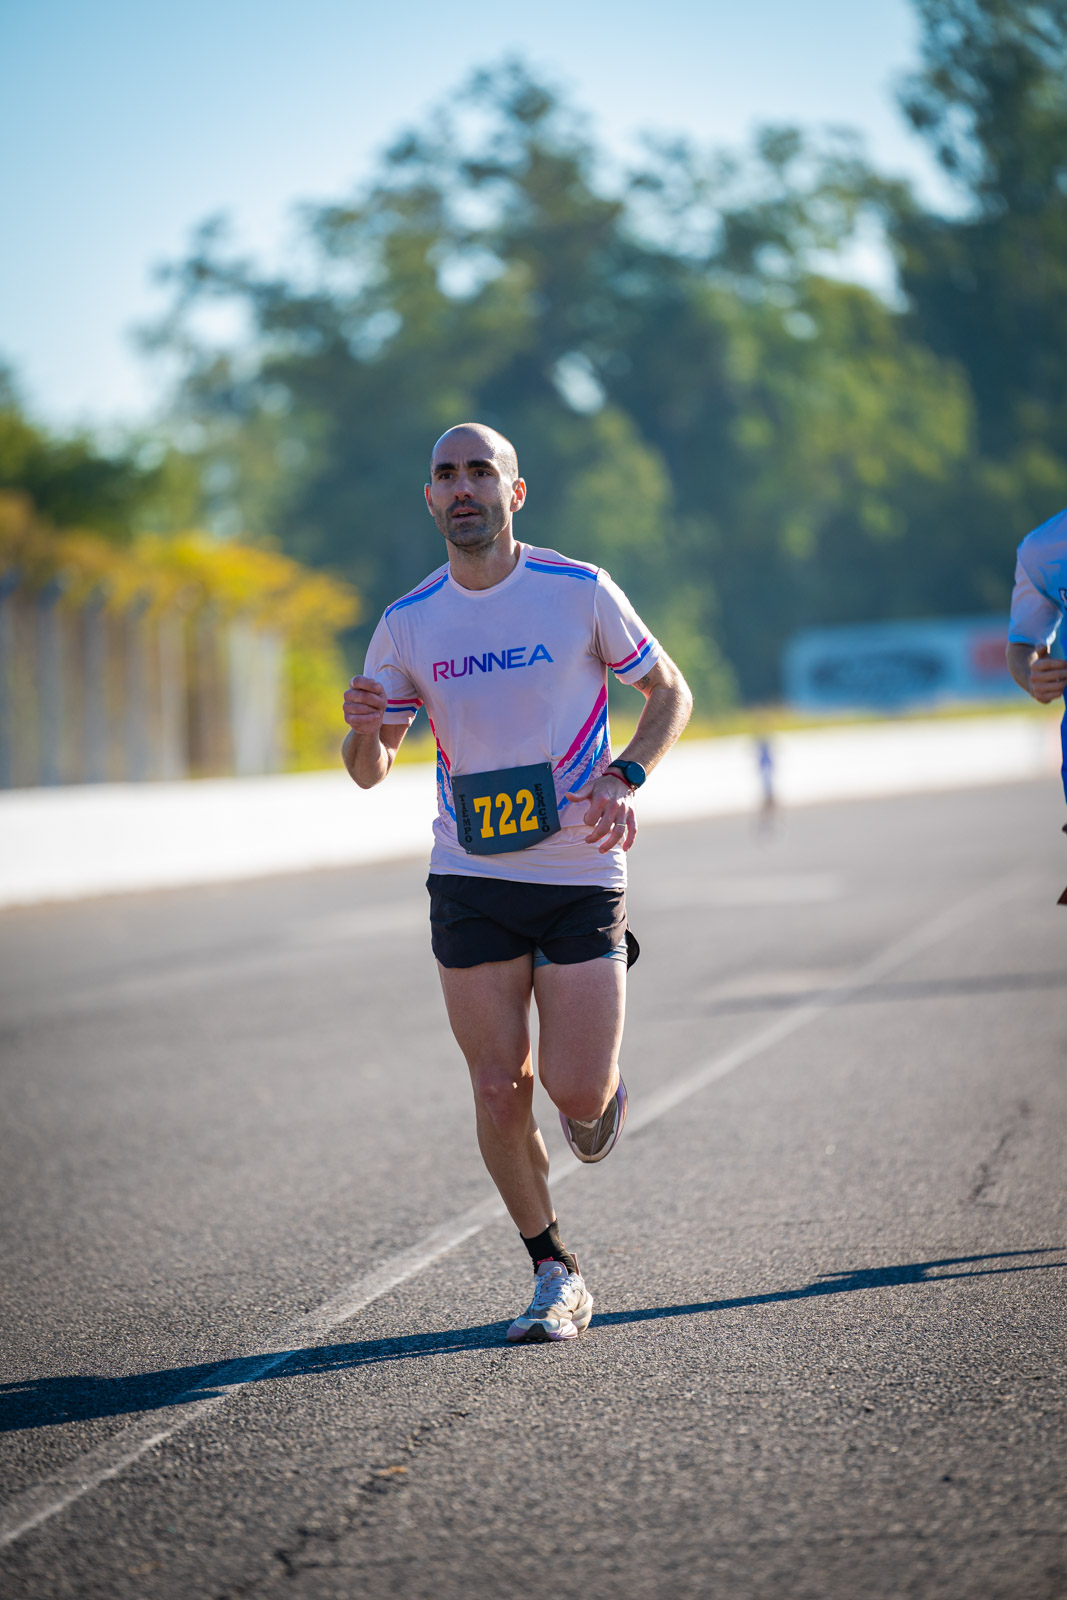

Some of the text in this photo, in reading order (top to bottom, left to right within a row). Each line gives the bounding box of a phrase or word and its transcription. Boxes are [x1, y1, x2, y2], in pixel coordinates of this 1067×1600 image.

[433, 644, 554, 682] RUNNEA
[459, 794, 473, 843] TIEMPO
[473, 789, 539, 839] 722
[534, 784, 551, 833] EXACTO
